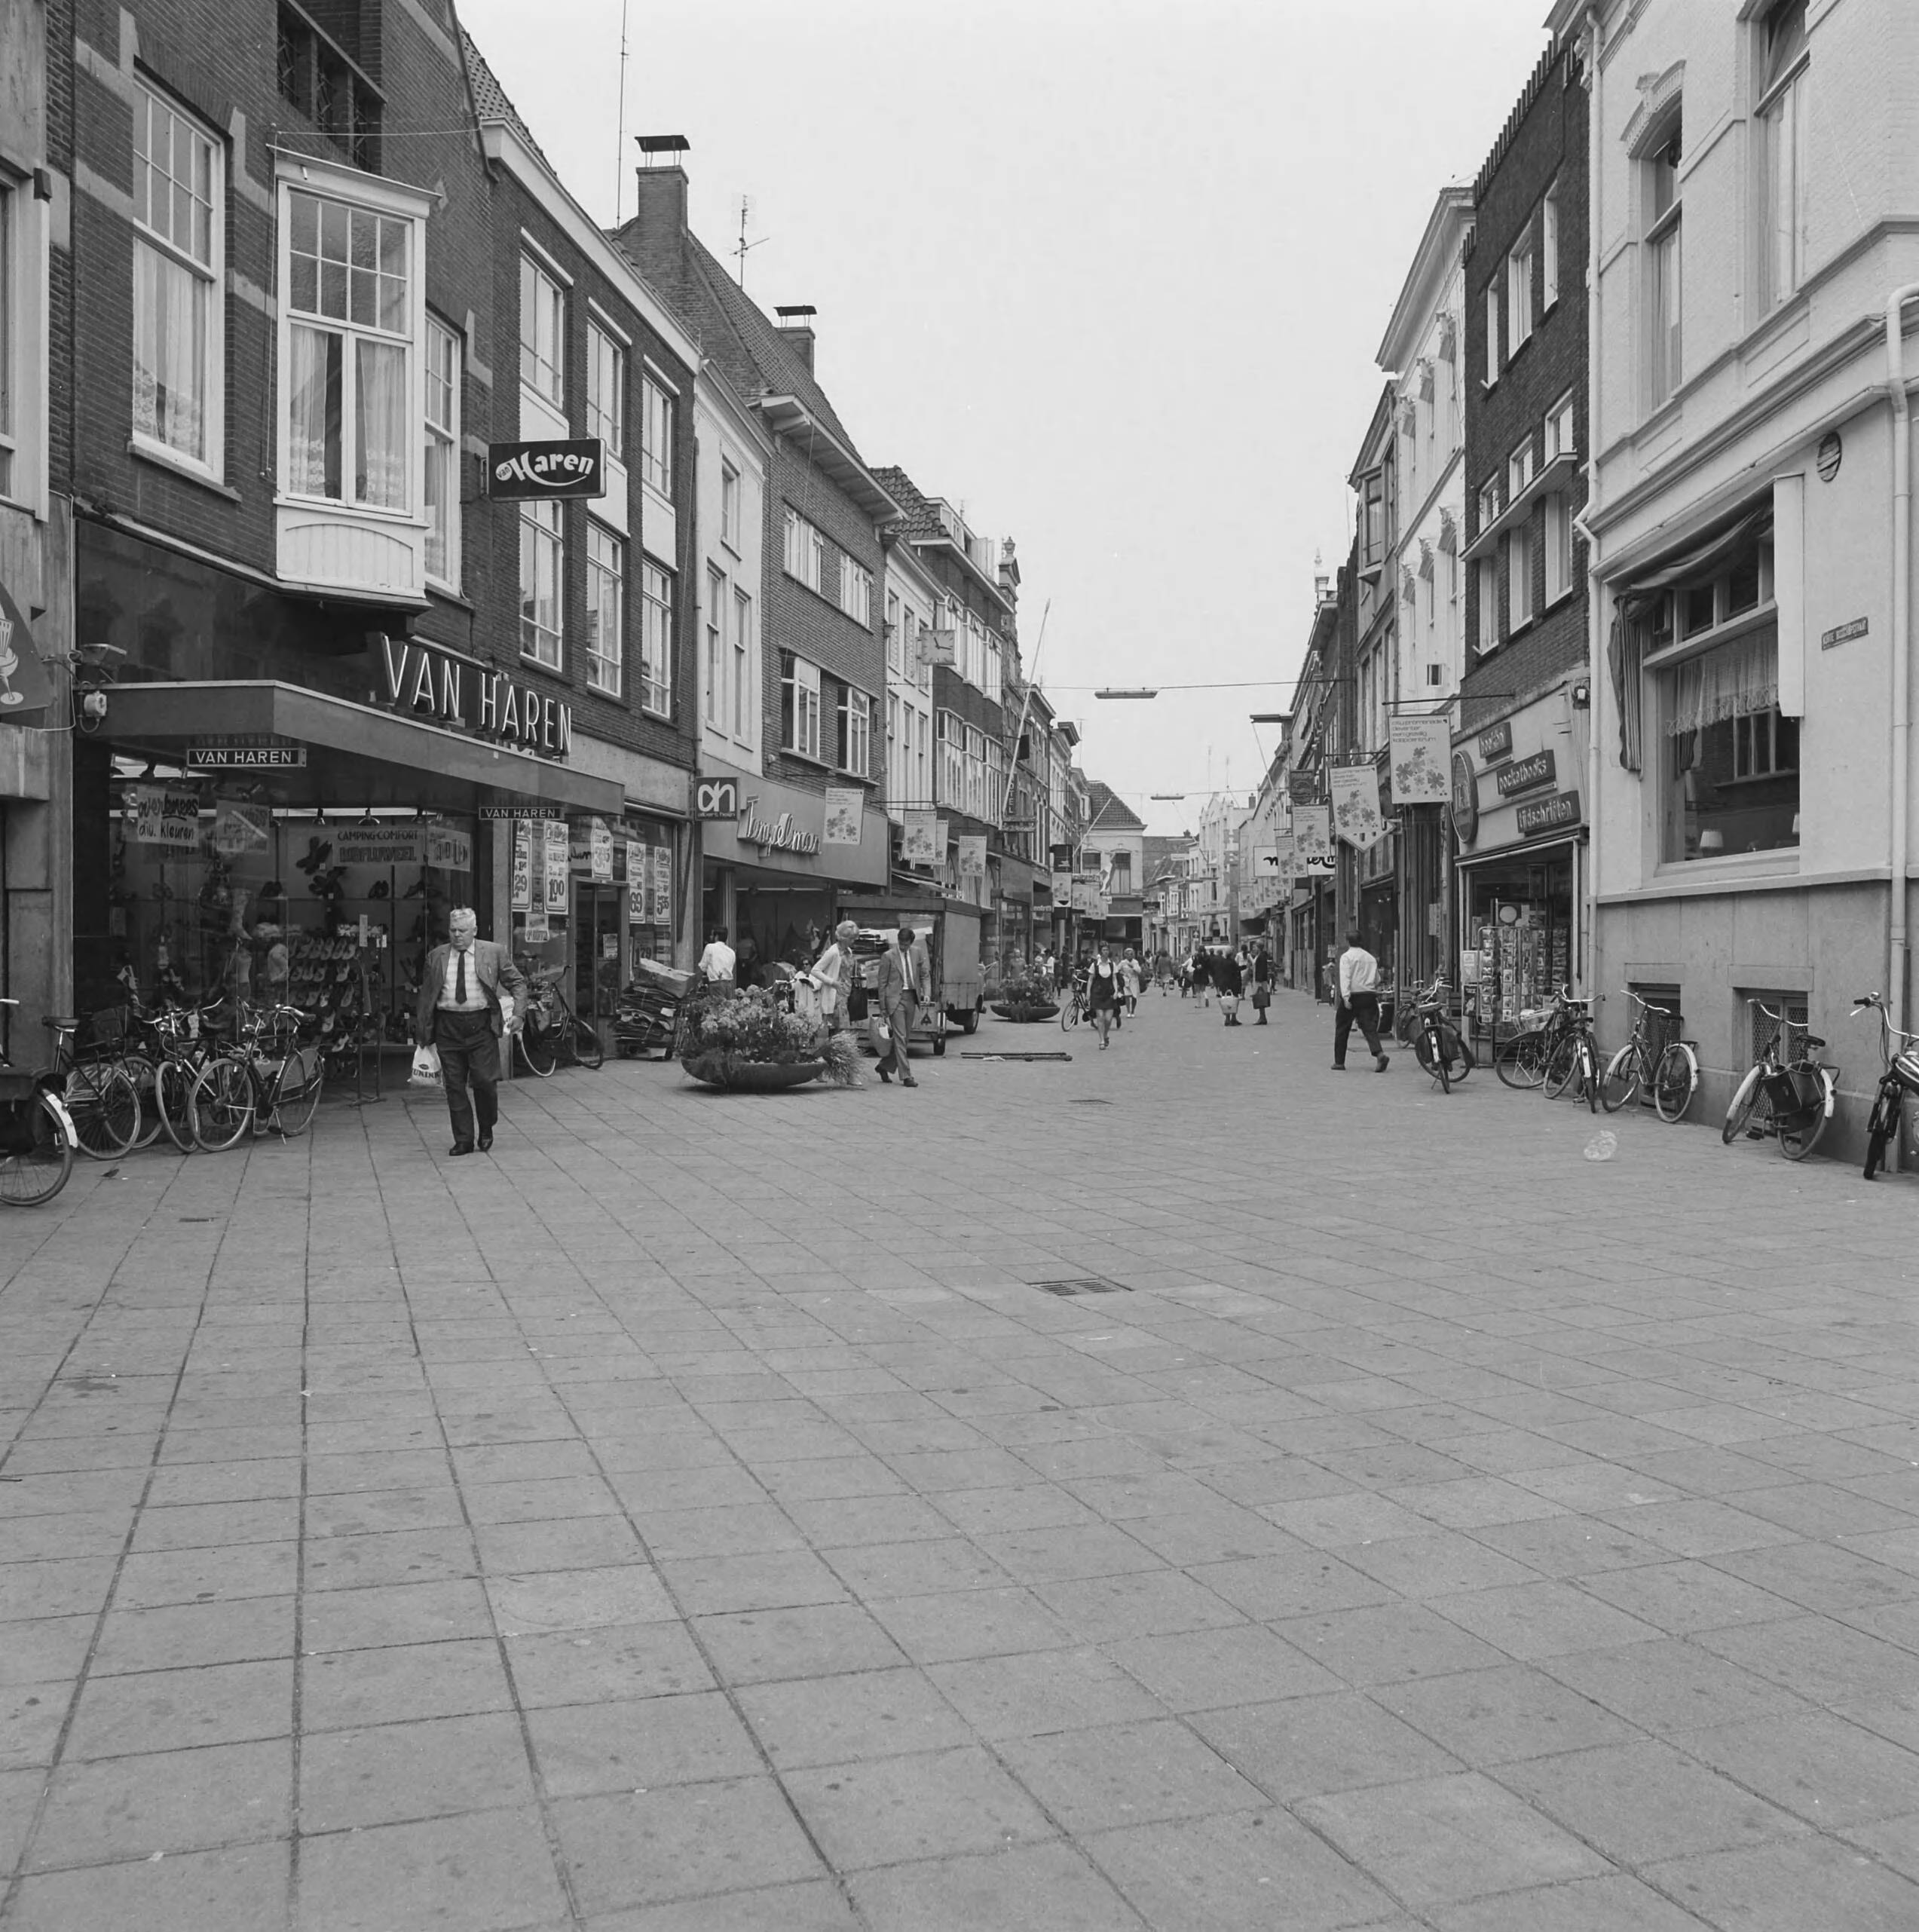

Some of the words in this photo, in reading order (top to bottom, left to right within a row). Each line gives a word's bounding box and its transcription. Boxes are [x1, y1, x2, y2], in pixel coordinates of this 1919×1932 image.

[497, 467, 510, 479] van
[508, 451, 594, 486] Haren
[384, 635, 461, 718] VAN
[482, 672, 572, 753] HAREN
[196, 751, 227, 764] VAN
[234, 751, 292, 764] HAREN
[485, 809, 509, 818] VAN
[513, 809, 556, 819] HAREN
[747, 797, 821, 856] Tempelman
